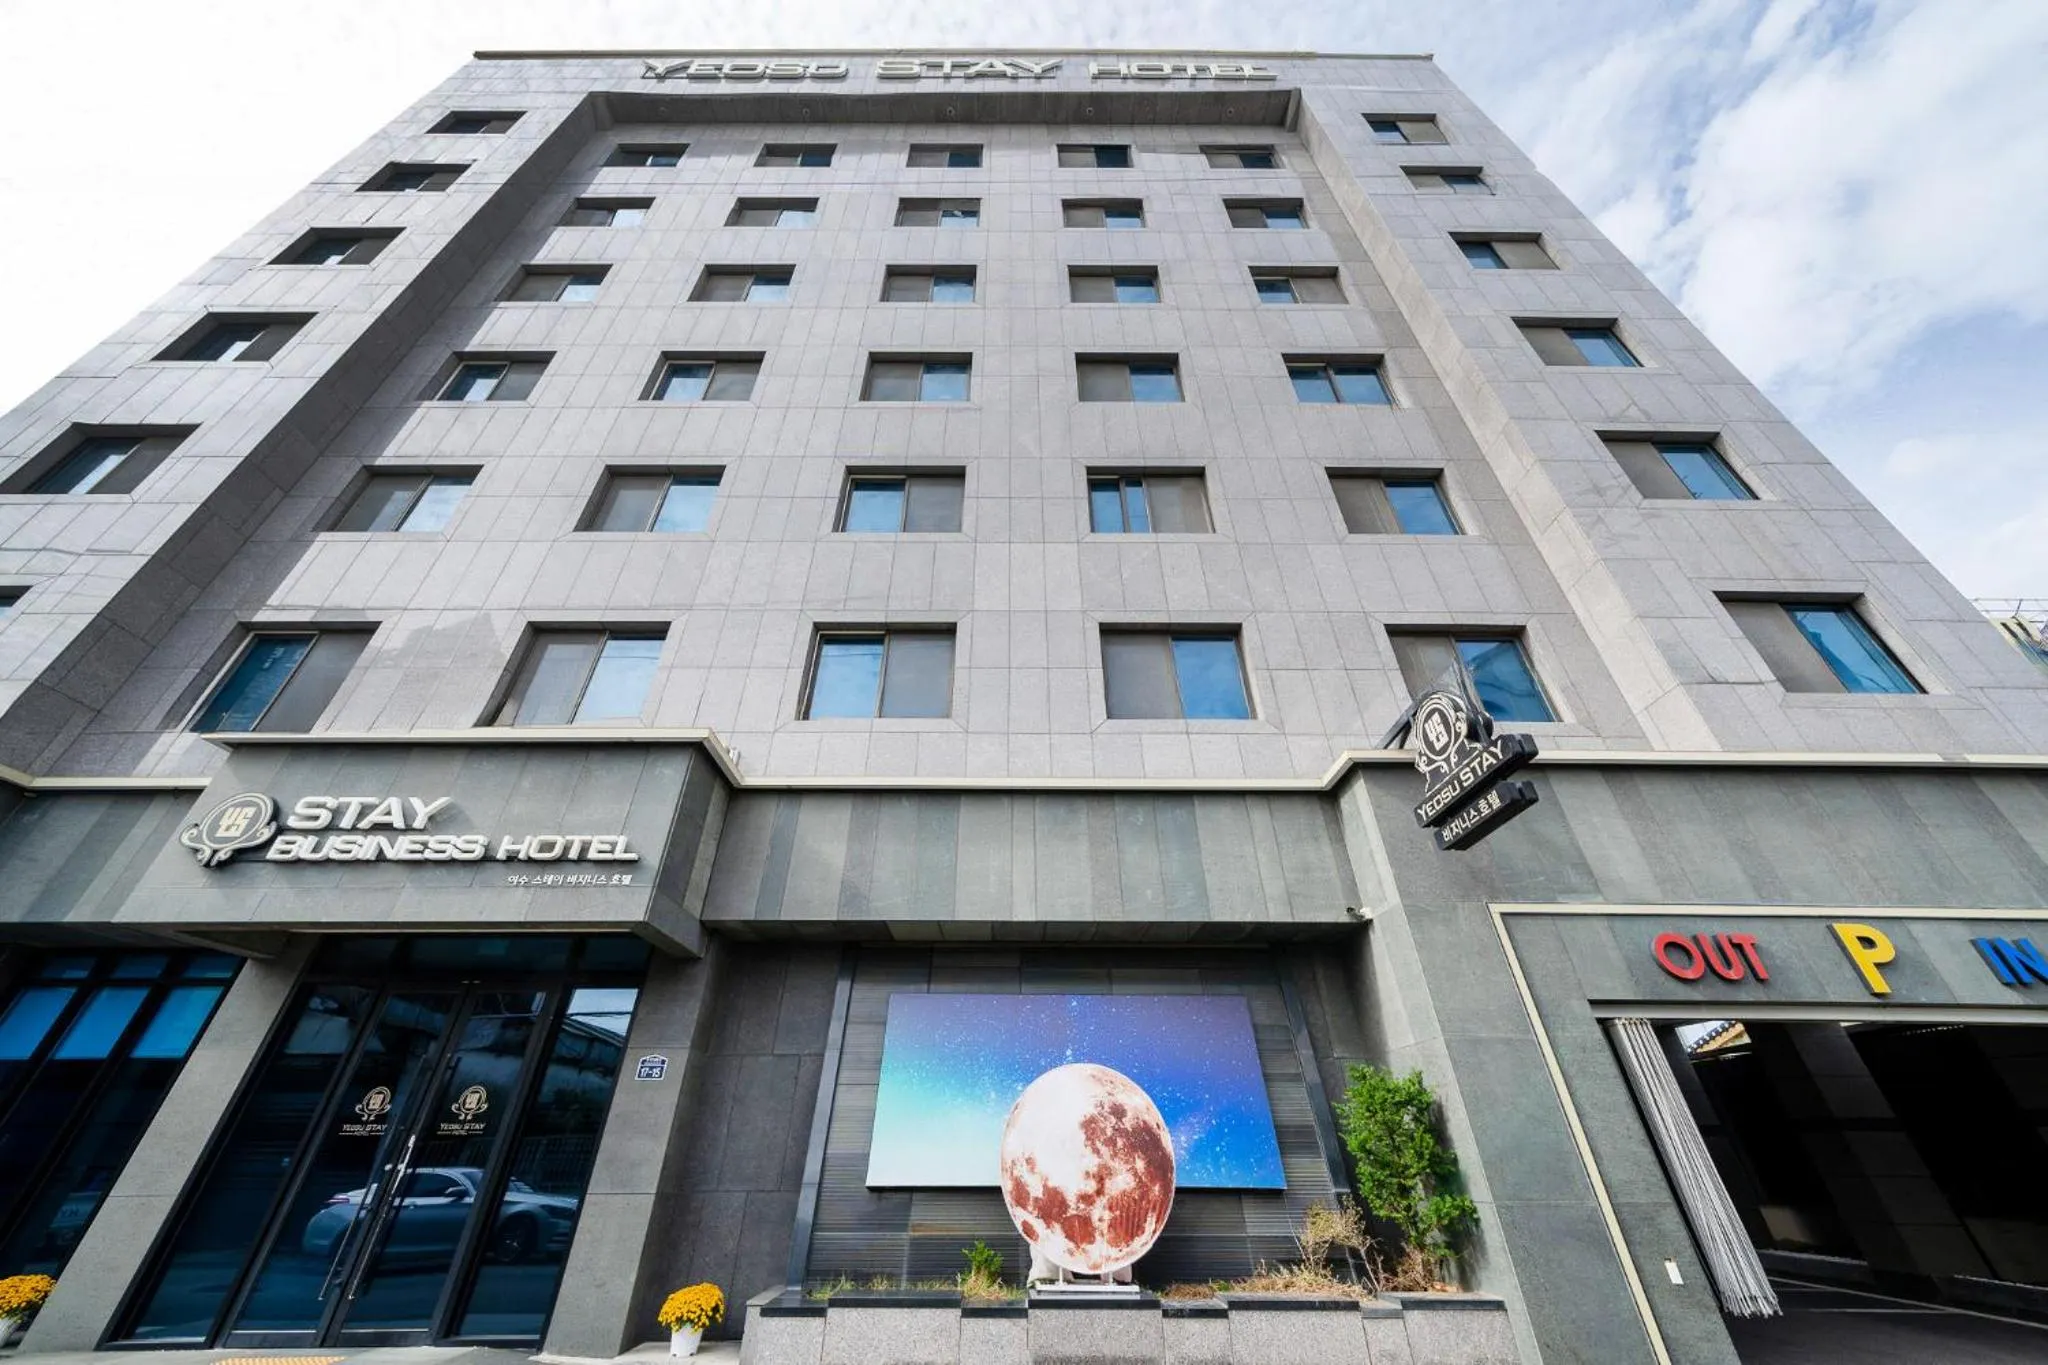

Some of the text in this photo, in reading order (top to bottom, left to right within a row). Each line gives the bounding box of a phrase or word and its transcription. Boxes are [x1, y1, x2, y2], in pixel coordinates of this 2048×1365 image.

[640, 59, 1279, 79] YEOSU STAY HOTEL
[1417, 739, 1503, 821] YEOSU STAY
[285, 796, 452, 830] STAY
[265, 835, 640, 861] BUSINESS HOTEL
[507, 874, 529, 885] 여수
[531, 874, 563, 886] 스테이
[1652, 932, 1768, 981] OUT
[1826, 922, 1896, 998] P
[1971, 936, 2048, 985] IN
[463, 1122, 486, 1130] STAY
